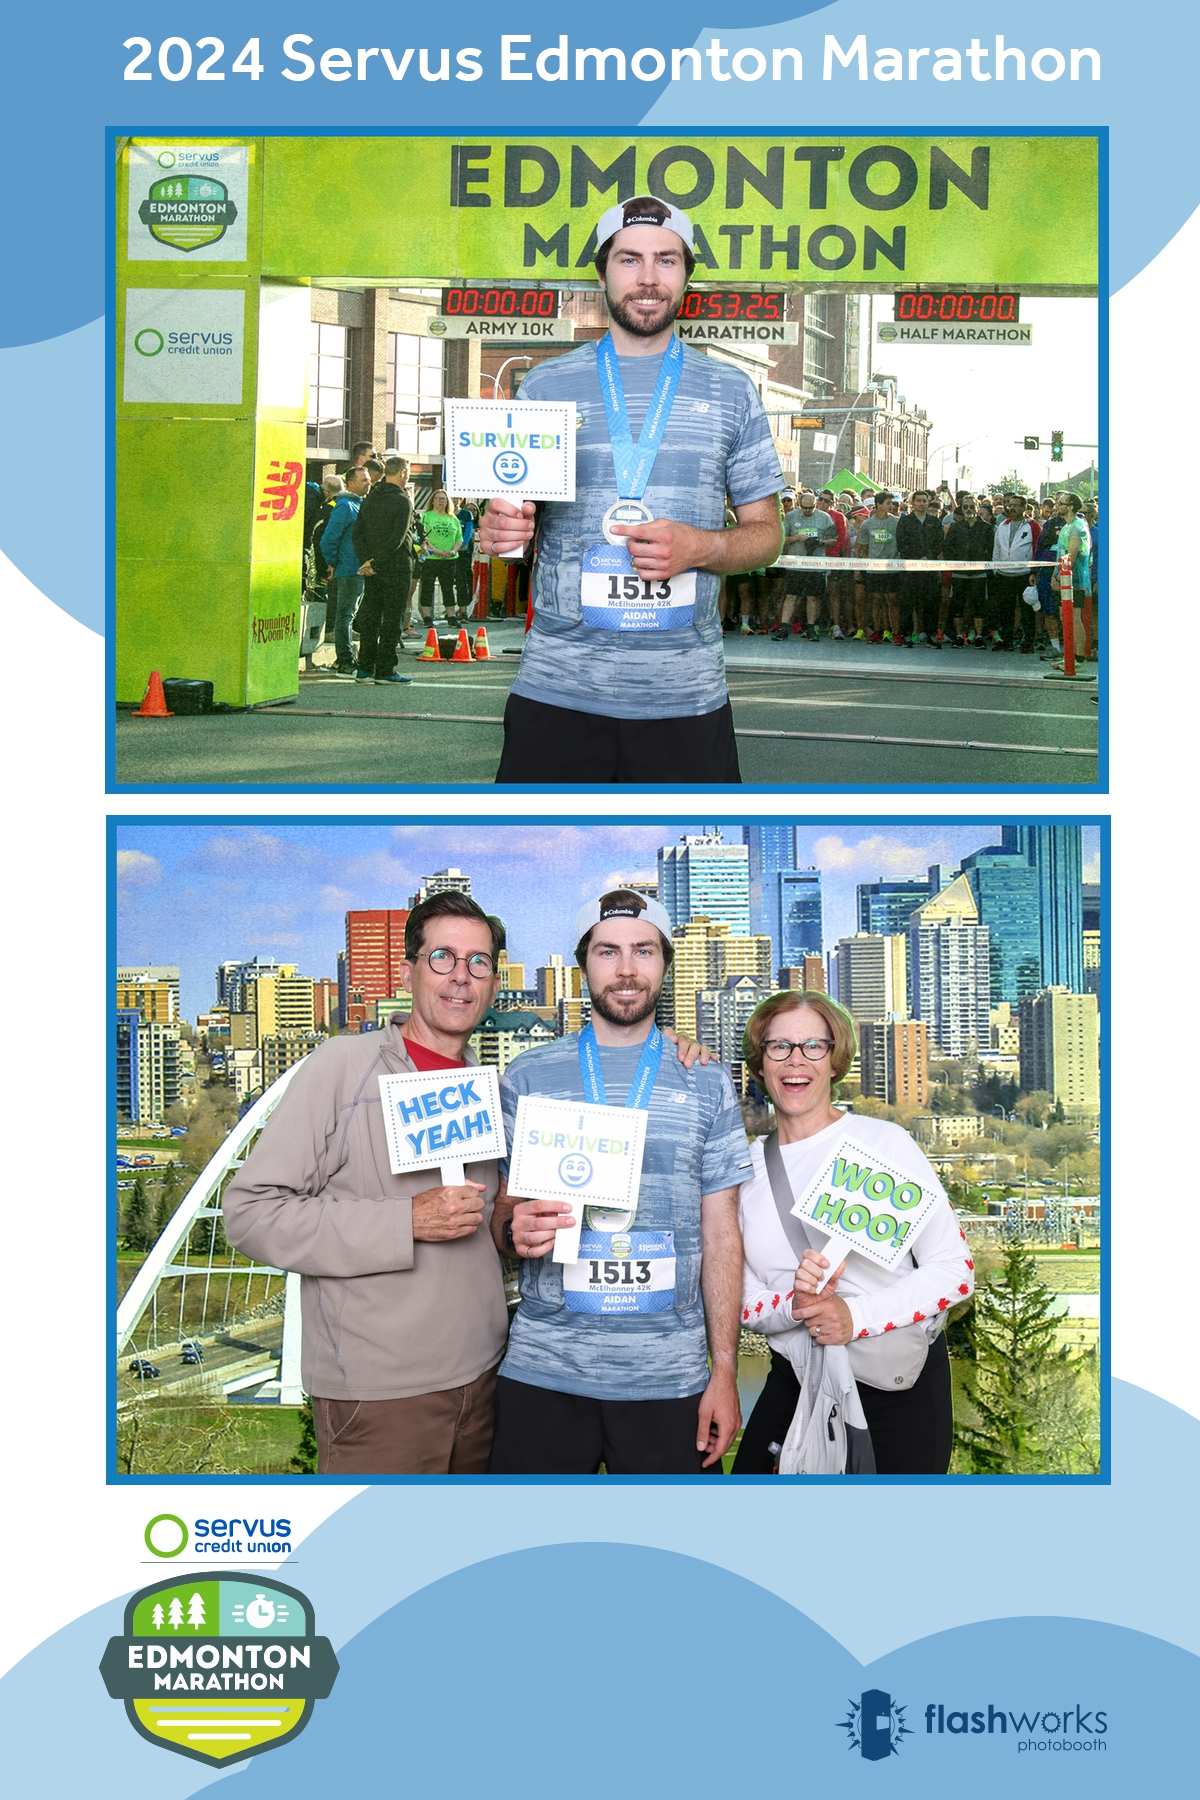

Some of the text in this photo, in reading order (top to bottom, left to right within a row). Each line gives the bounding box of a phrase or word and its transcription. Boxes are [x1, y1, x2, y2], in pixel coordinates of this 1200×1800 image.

[178, 152, 219, 162] servus
[450, 144, 990, 211] EDMONTON
[150, 203, 227, 214] EDMONTON
[160, 214, 216, 222] MARATHON
[631, 215, 658, 223] Columbia
[523, 223, 907, 272] MATHON
[465, 321, 555, 336] ARMY 10K
[678, 325, 785, 341] MARATHON
[900, 328, 939, 340] HALF
[942, 328, 1031, 341] MARATHON
[168, 332, 233, 345] servus
[168, 345, 233, 355] credit union
[604, 351, 619, 412] MARATHON FINISHER
[648, 375, 672, 439] MARATHON FINISHER
[507, 413, 512, 428] I
[459, 431, 560, 450] SURVIVED!
[628, 458, 646, 498] credit union
[608, 575, 672, 600] 1513
[608, 600, 655, 608] McElhanney
[622, 611, 656, 620] AIDAN
[586, 1041, 600, 1102] MARATHON FINISHER
[638, 1066, 650, 1096] FINISHER
[396, 1079, 482, 1127] HECK
[578, 1115, 584, 1130] I
[405, 1109, 493, 1159] YEAH!
[527, 1130, 630, 1156] SURVIVED!
[831, 1157, 922, 1211] WOO
[810, 1192, 912, 1248] HOO!
[588, 1260, 651, 1284] 1513
[603, 1295, 636, 1304] AIDAN
